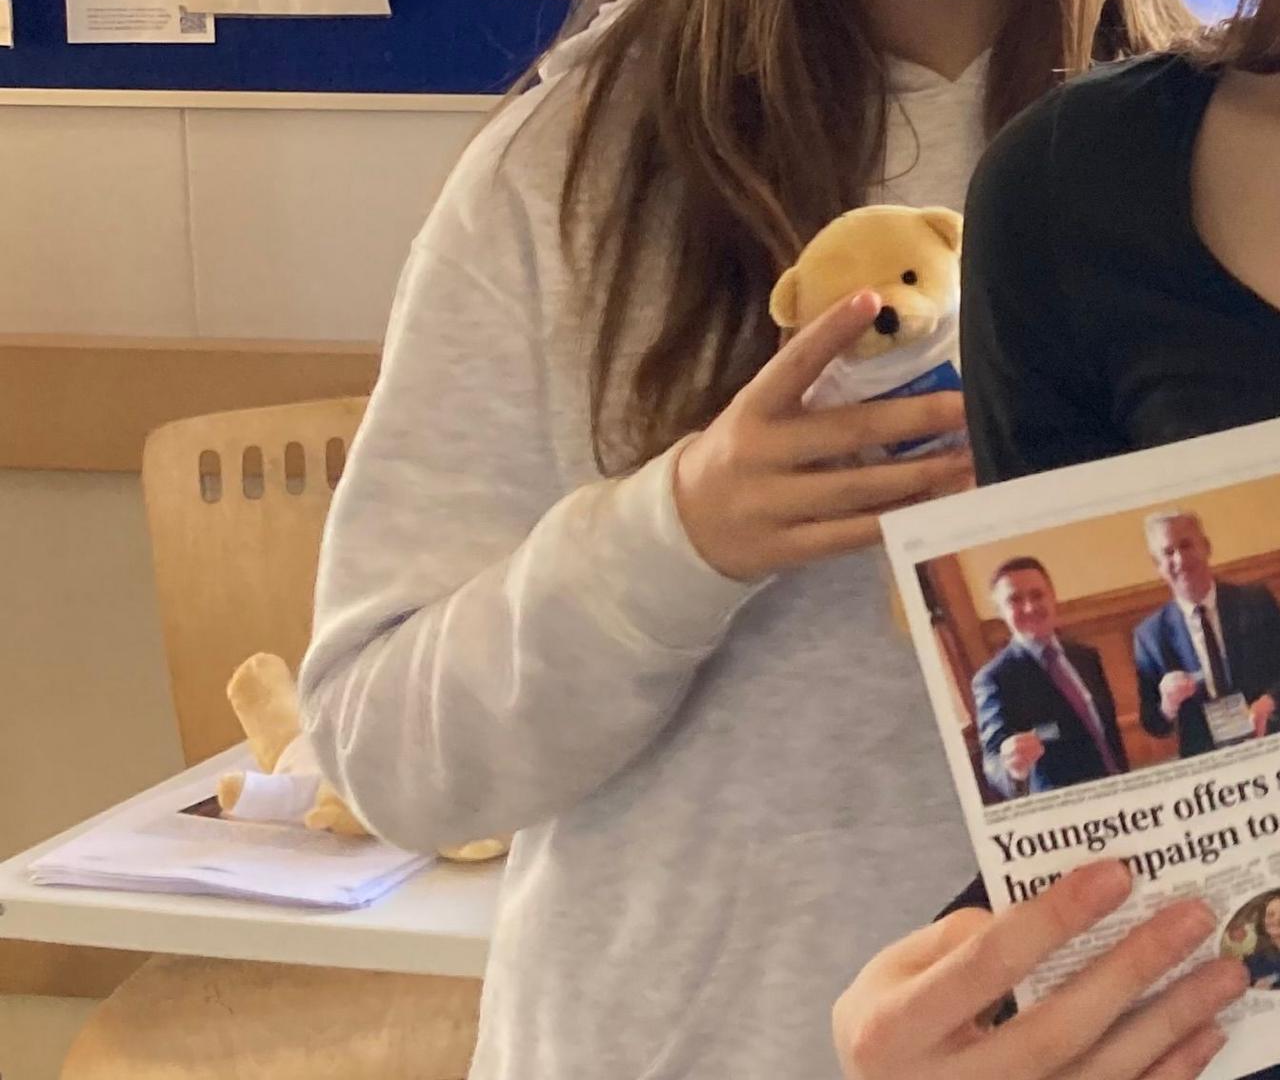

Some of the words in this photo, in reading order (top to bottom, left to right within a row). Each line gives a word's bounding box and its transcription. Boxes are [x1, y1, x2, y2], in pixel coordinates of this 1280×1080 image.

[994, 806, 1164, 864] Youngster
[1174, 778, 1270, 818] offers
[1119, 822, 1240, 884] mpaign
[1248, 809, 1280, 840] to
